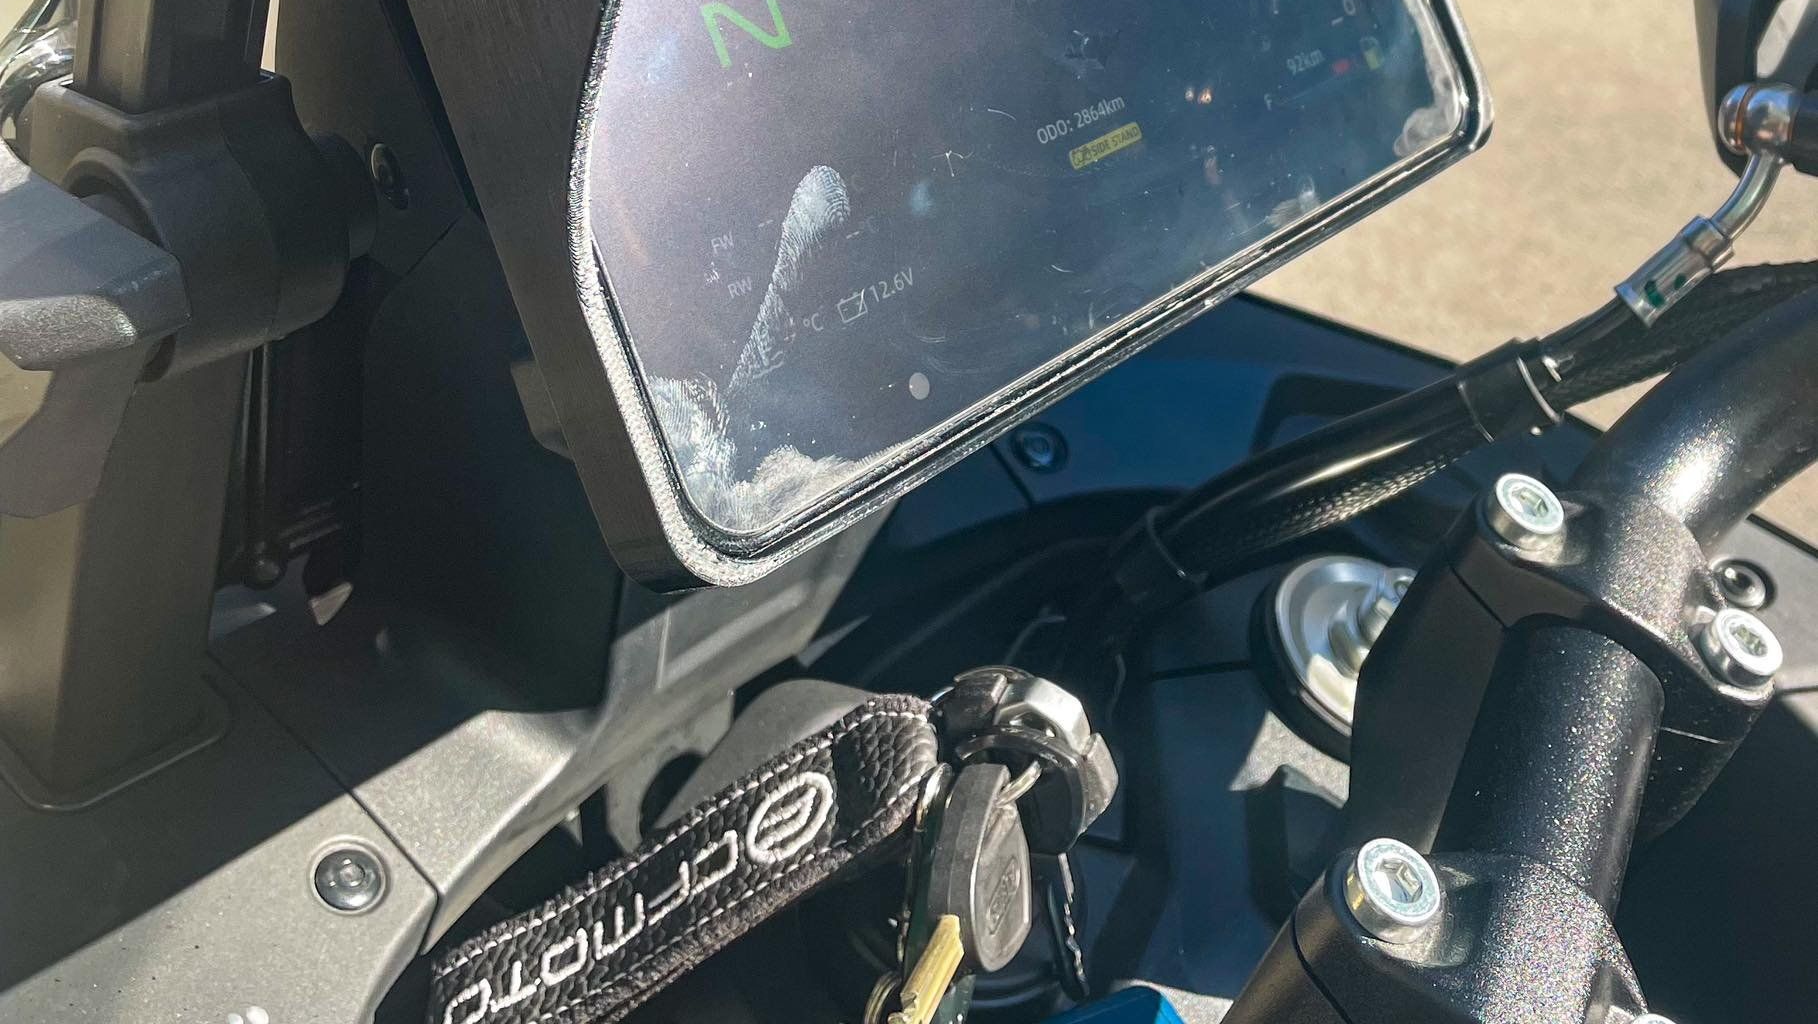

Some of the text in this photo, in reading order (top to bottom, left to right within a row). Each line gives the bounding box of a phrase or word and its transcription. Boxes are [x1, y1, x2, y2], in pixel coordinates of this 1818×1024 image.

[1036, 96, 1126, 145] ODO: 2864km
[1111, 126, 1140, 148] STAND
[710, 230, 735, 255] FW
[726, 277, 753, 300] RW
[868, 267, 915, 303] 12.6V
